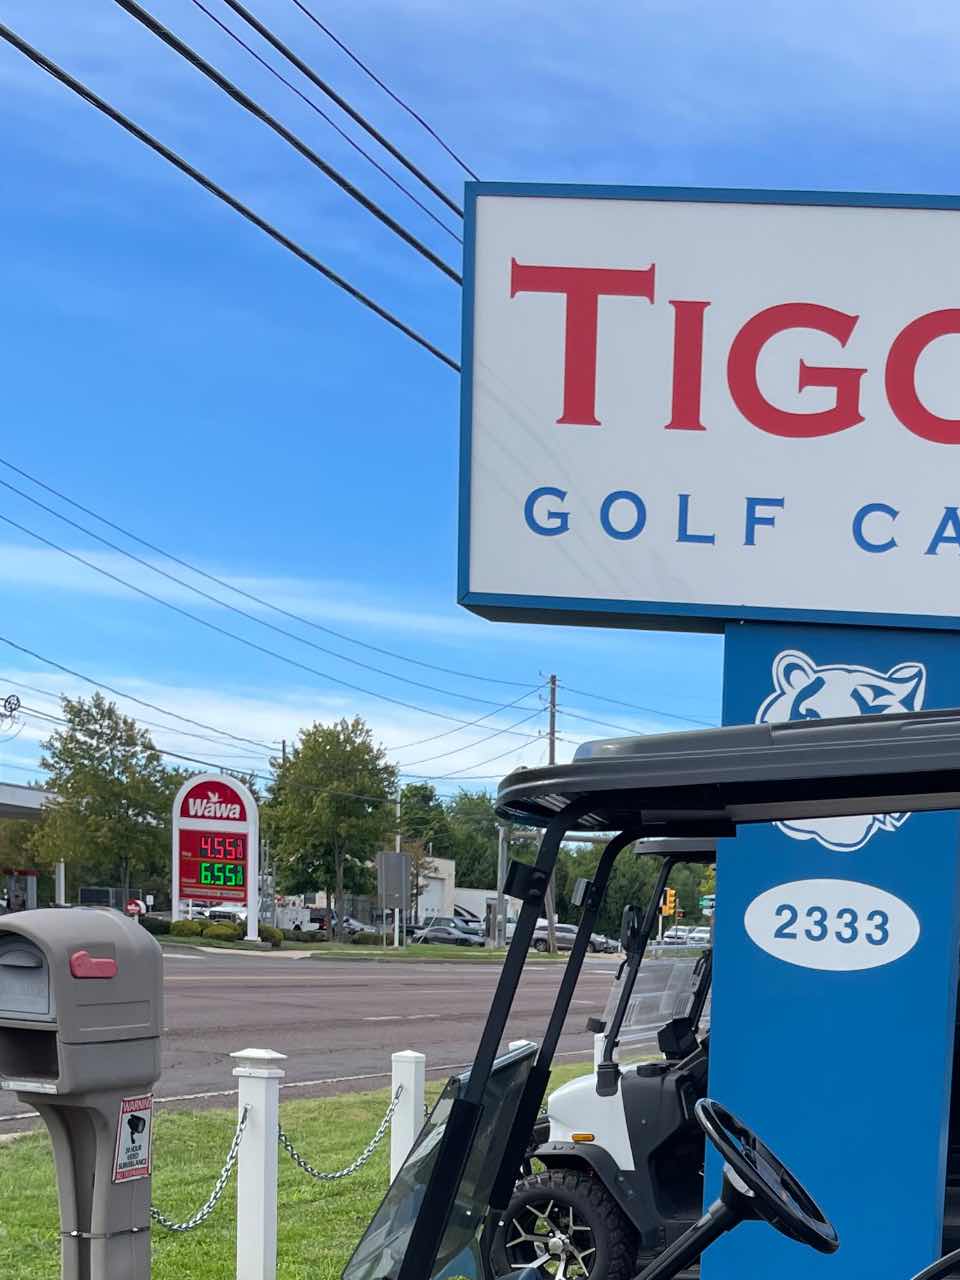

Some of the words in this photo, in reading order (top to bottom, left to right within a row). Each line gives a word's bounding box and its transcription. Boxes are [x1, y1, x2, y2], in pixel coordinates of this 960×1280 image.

[523, 486, 786, 547] GOLF
[188, 798, 241, 819] Wawa
[773, 903, 890, 946] 2333
